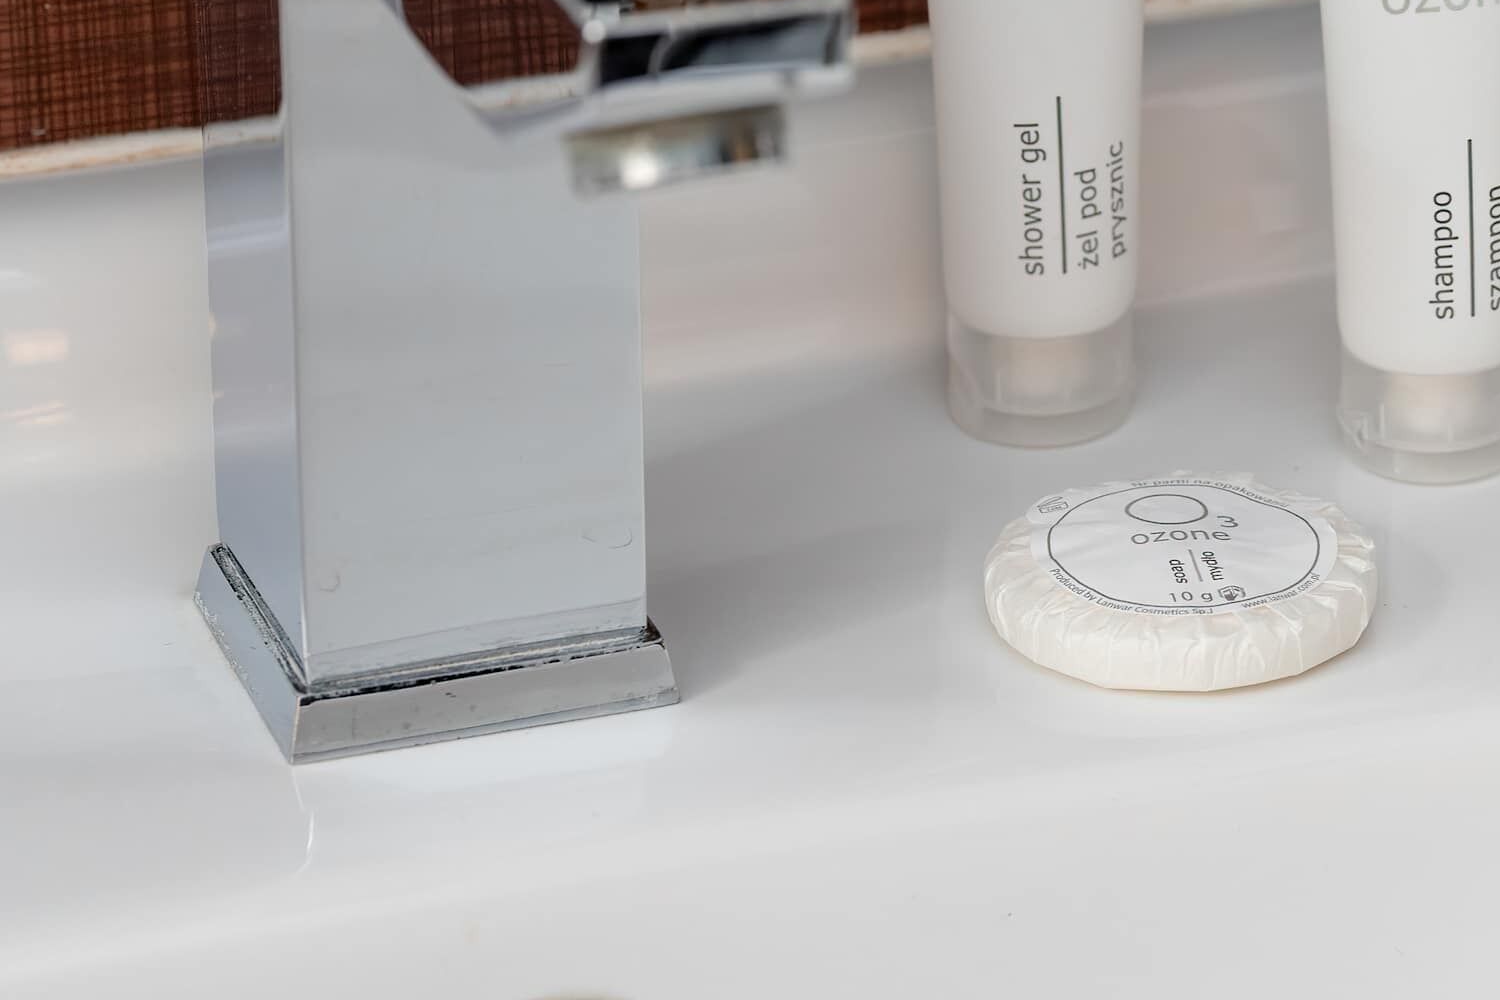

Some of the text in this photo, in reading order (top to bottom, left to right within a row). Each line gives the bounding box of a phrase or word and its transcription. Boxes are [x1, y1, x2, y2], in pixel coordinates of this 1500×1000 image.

[1013, 123, 1047, 275] shower gel
[1074, 167, 1101, 269] żel pod
[1107, 141, 1126, 259] prysznic
[1429, 191, 1459, 319] shampoo
[1131, 530, 1231, 544] ozone
[1169, 559, 1188, 583] soap
[1050, 568, 1085, 596] Produced
[1084, 590, 1097, 601] by
[1096, 597, 1133, 611] Lanwar
[1134, 606, 1190, 615] Cosmetics
[1169, 591, 1214, 602] 10 g
